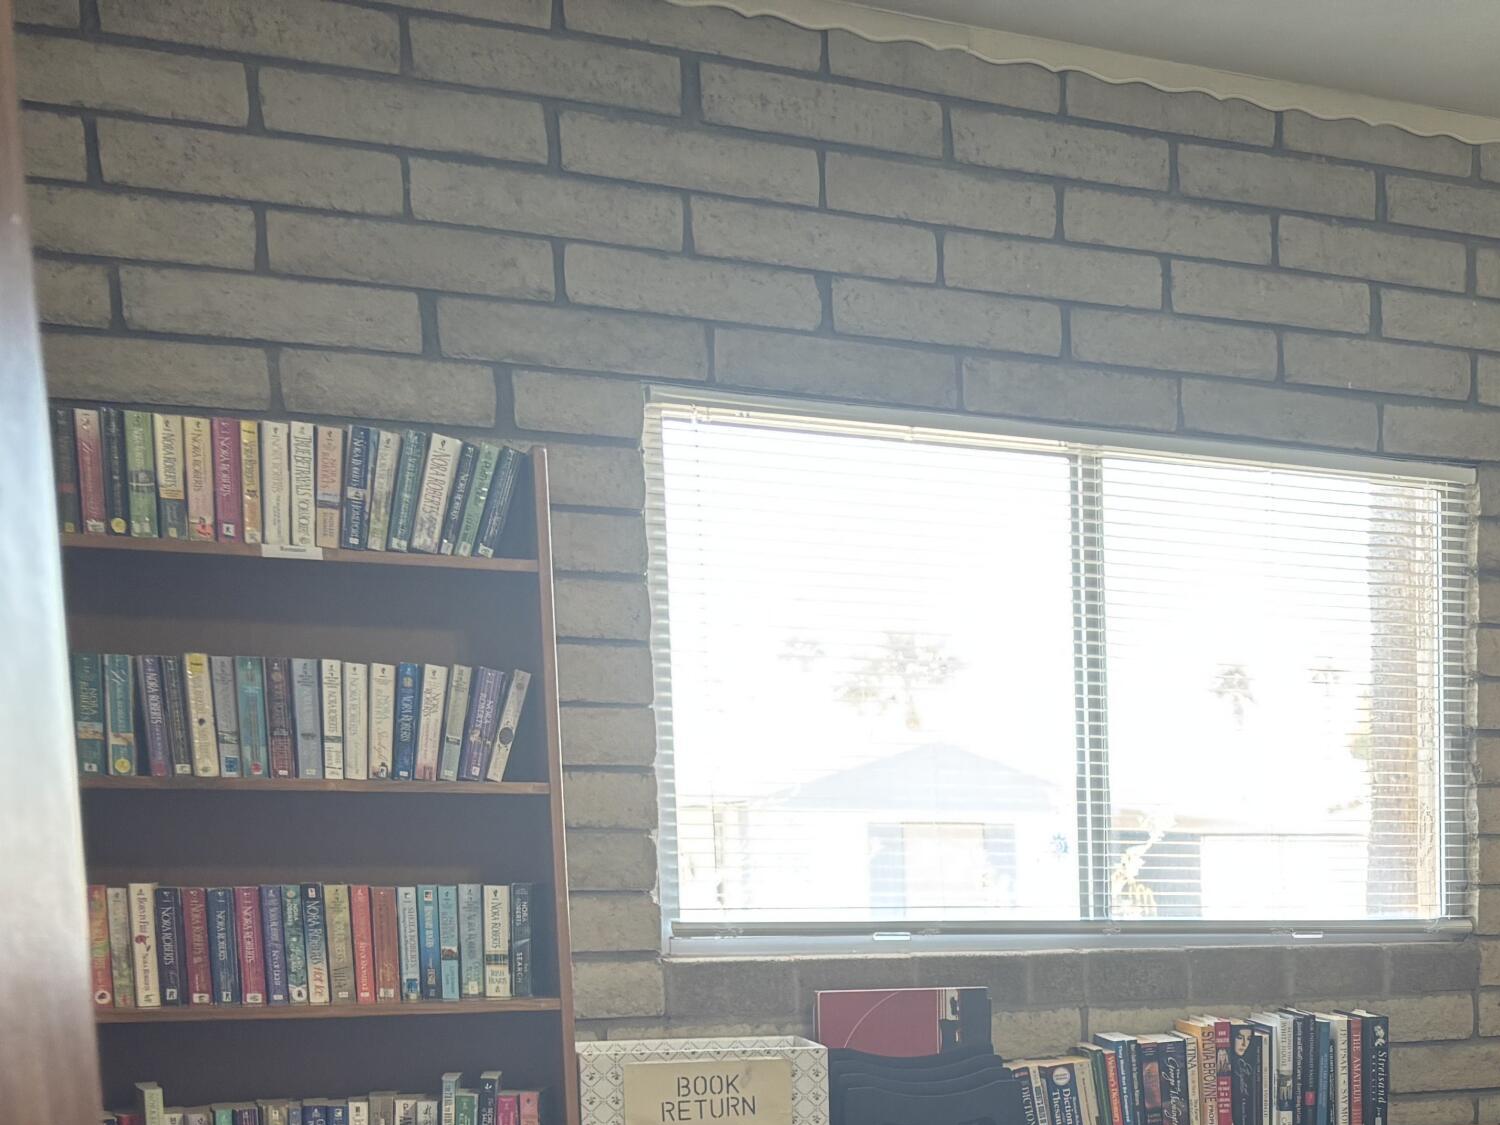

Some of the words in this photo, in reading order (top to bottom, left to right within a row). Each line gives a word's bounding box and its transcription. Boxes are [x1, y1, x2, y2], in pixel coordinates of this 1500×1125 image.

[1201, 1031, 1215, 1063] SYLVIA
[676, 1073, 741, 1097] BOOK
[1202, 1063, 1217, 1103] BROWNE
[1375, 1050, 1388, 1103] Streisand
[661, 1094, 757, 1123] RETURN
